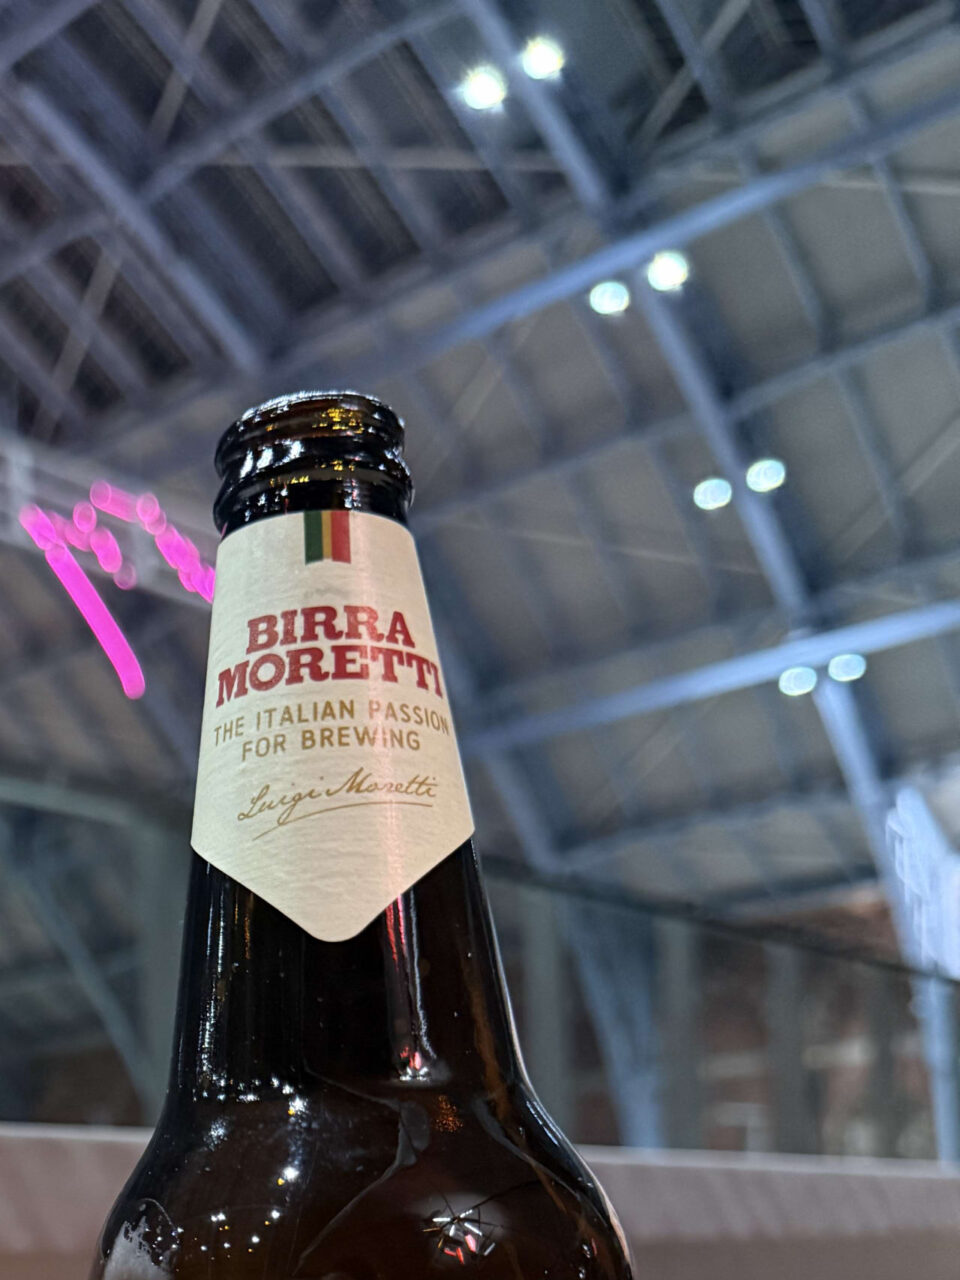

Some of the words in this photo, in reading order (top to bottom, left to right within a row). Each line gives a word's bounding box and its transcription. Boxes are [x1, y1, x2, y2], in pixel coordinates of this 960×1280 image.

[245, 604, 416, 655] BIRRA
[215, 645, 444, 708] MORETTI
[213, 715, 245, 747] THE
[255, 699, 356, 732] ITALIAN
[368, 699, 450, 737] PASSION
[241, 733, 287, 762] FOR
[300, 725, 421, 751] BREWING
[237, 775, 324, 826] Luigi
[326, 766, 438, 798] Moretti
